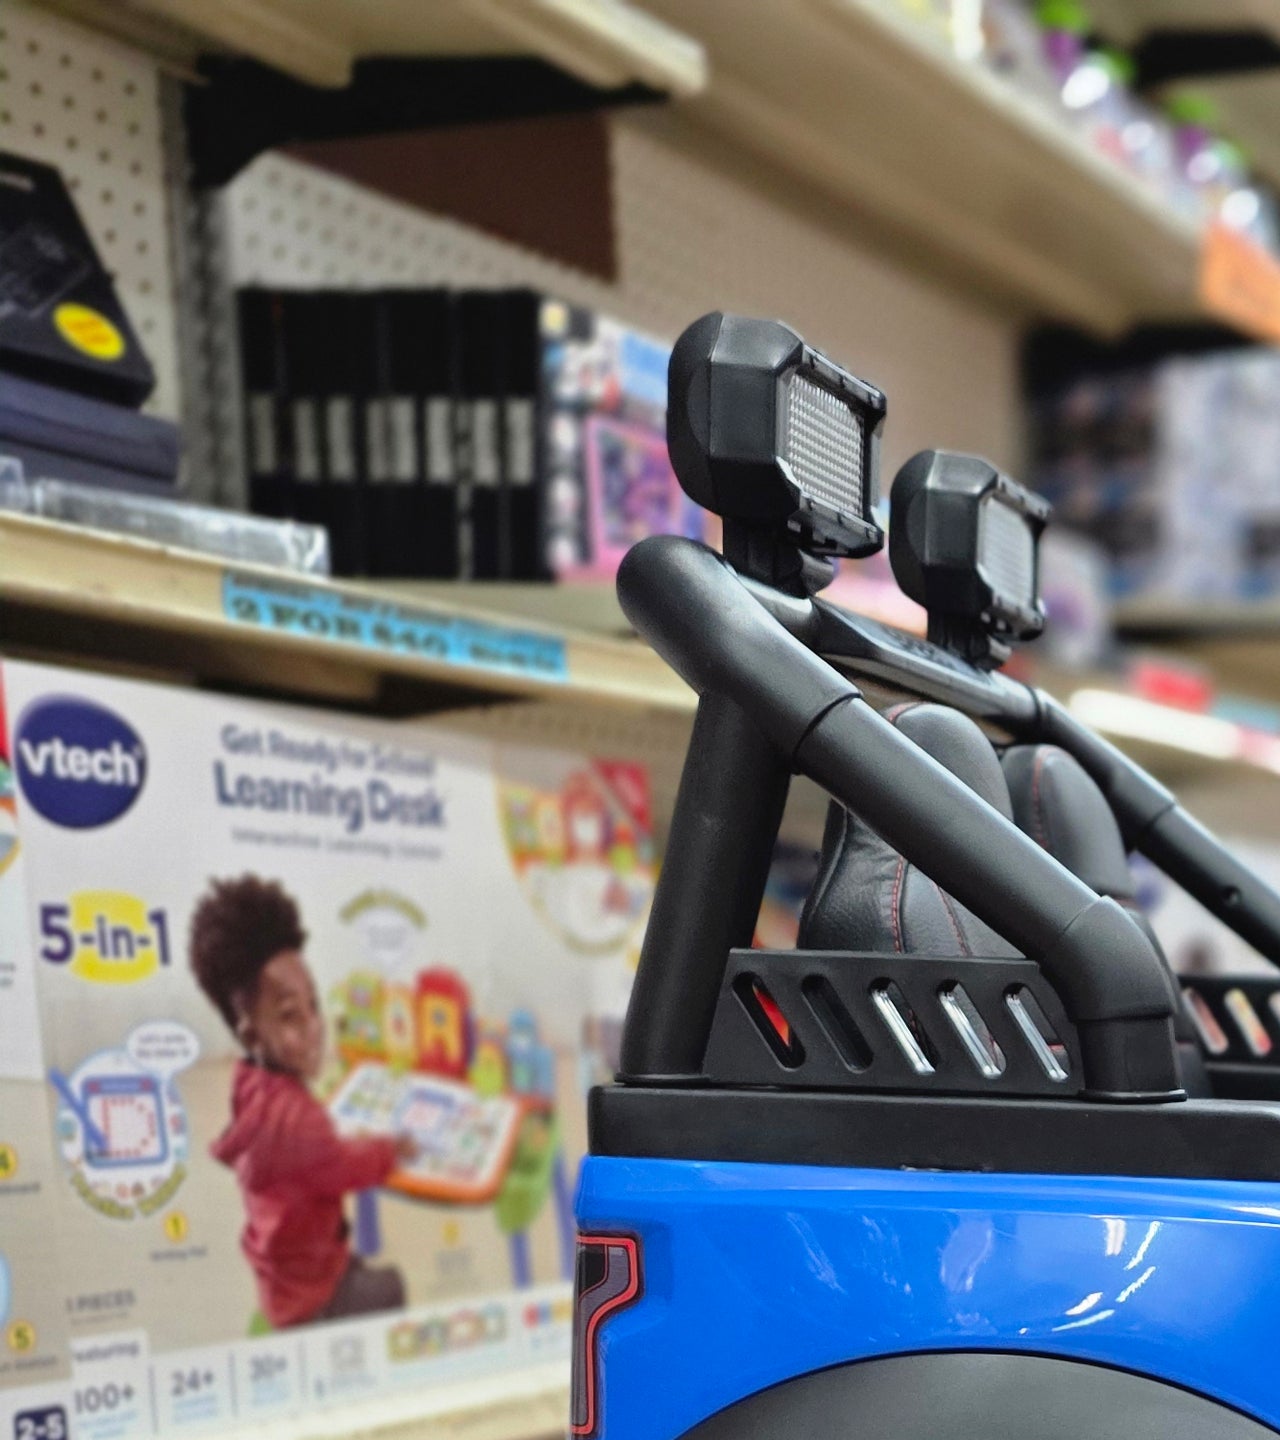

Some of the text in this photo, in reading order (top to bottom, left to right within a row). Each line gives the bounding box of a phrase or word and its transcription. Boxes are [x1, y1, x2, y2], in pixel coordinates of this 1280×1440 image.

[212, 758, 365, 834] Learning
[39, 902, 171, 966] 5-in-1
[75, 1382, 135, 1414] 100+
[172, 1369, 214, 1397] 24+
